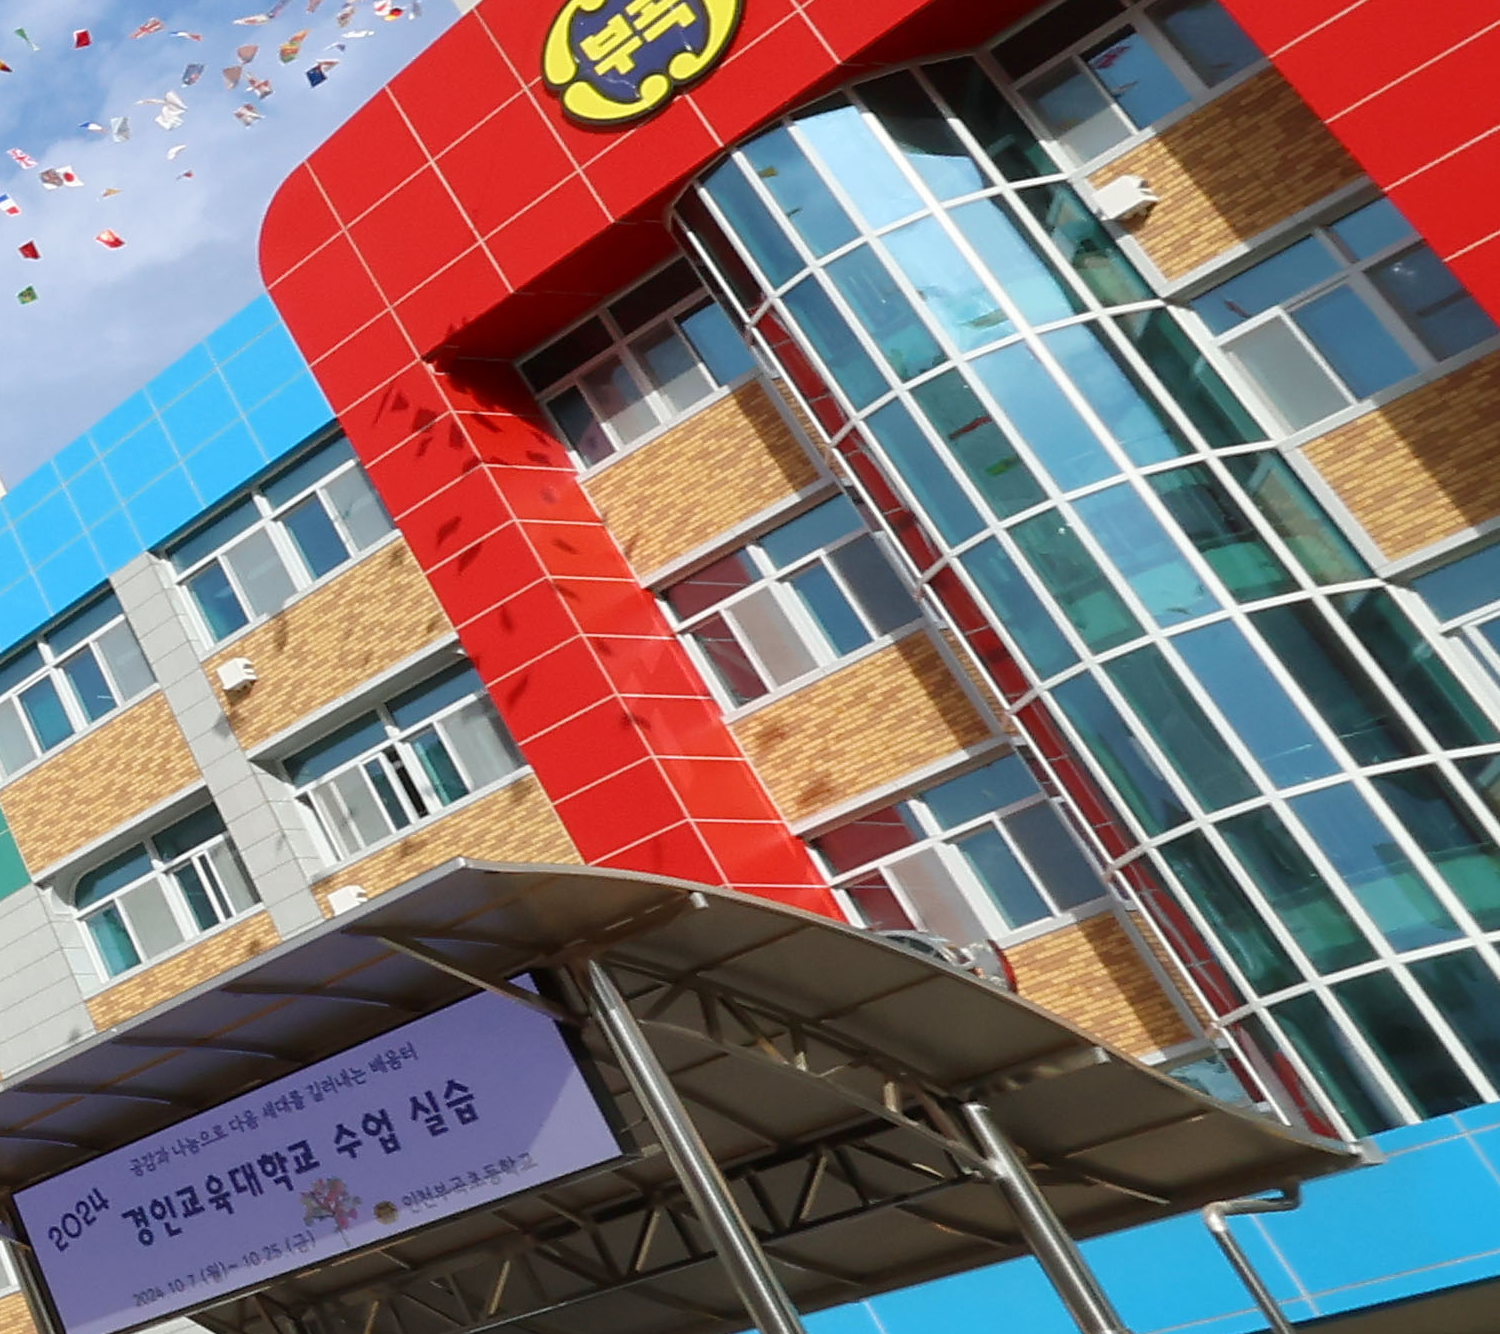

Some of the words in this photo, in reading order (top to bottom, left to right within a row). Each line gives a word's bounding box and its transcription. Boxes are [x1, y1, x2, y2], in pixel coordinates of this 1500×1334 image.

[121, 1139, 321, 1246] 경인교육대학교
[333, 1108, 401, 1159] 수업
[409, 1078, 479, 1137] 실습
[130, 1146, 170, 1177] 공감과
[171, 1124, 229, 1158] 나눔으로
[228, 1109, 260, 1134] 다음
[261, 1089, 305, 1119] 세대를
[306, 1067, 367, 1103] 길러내는
[368, 1042, 419, 1074] 배움터
[48, 1187, 111, 1253] 2024
